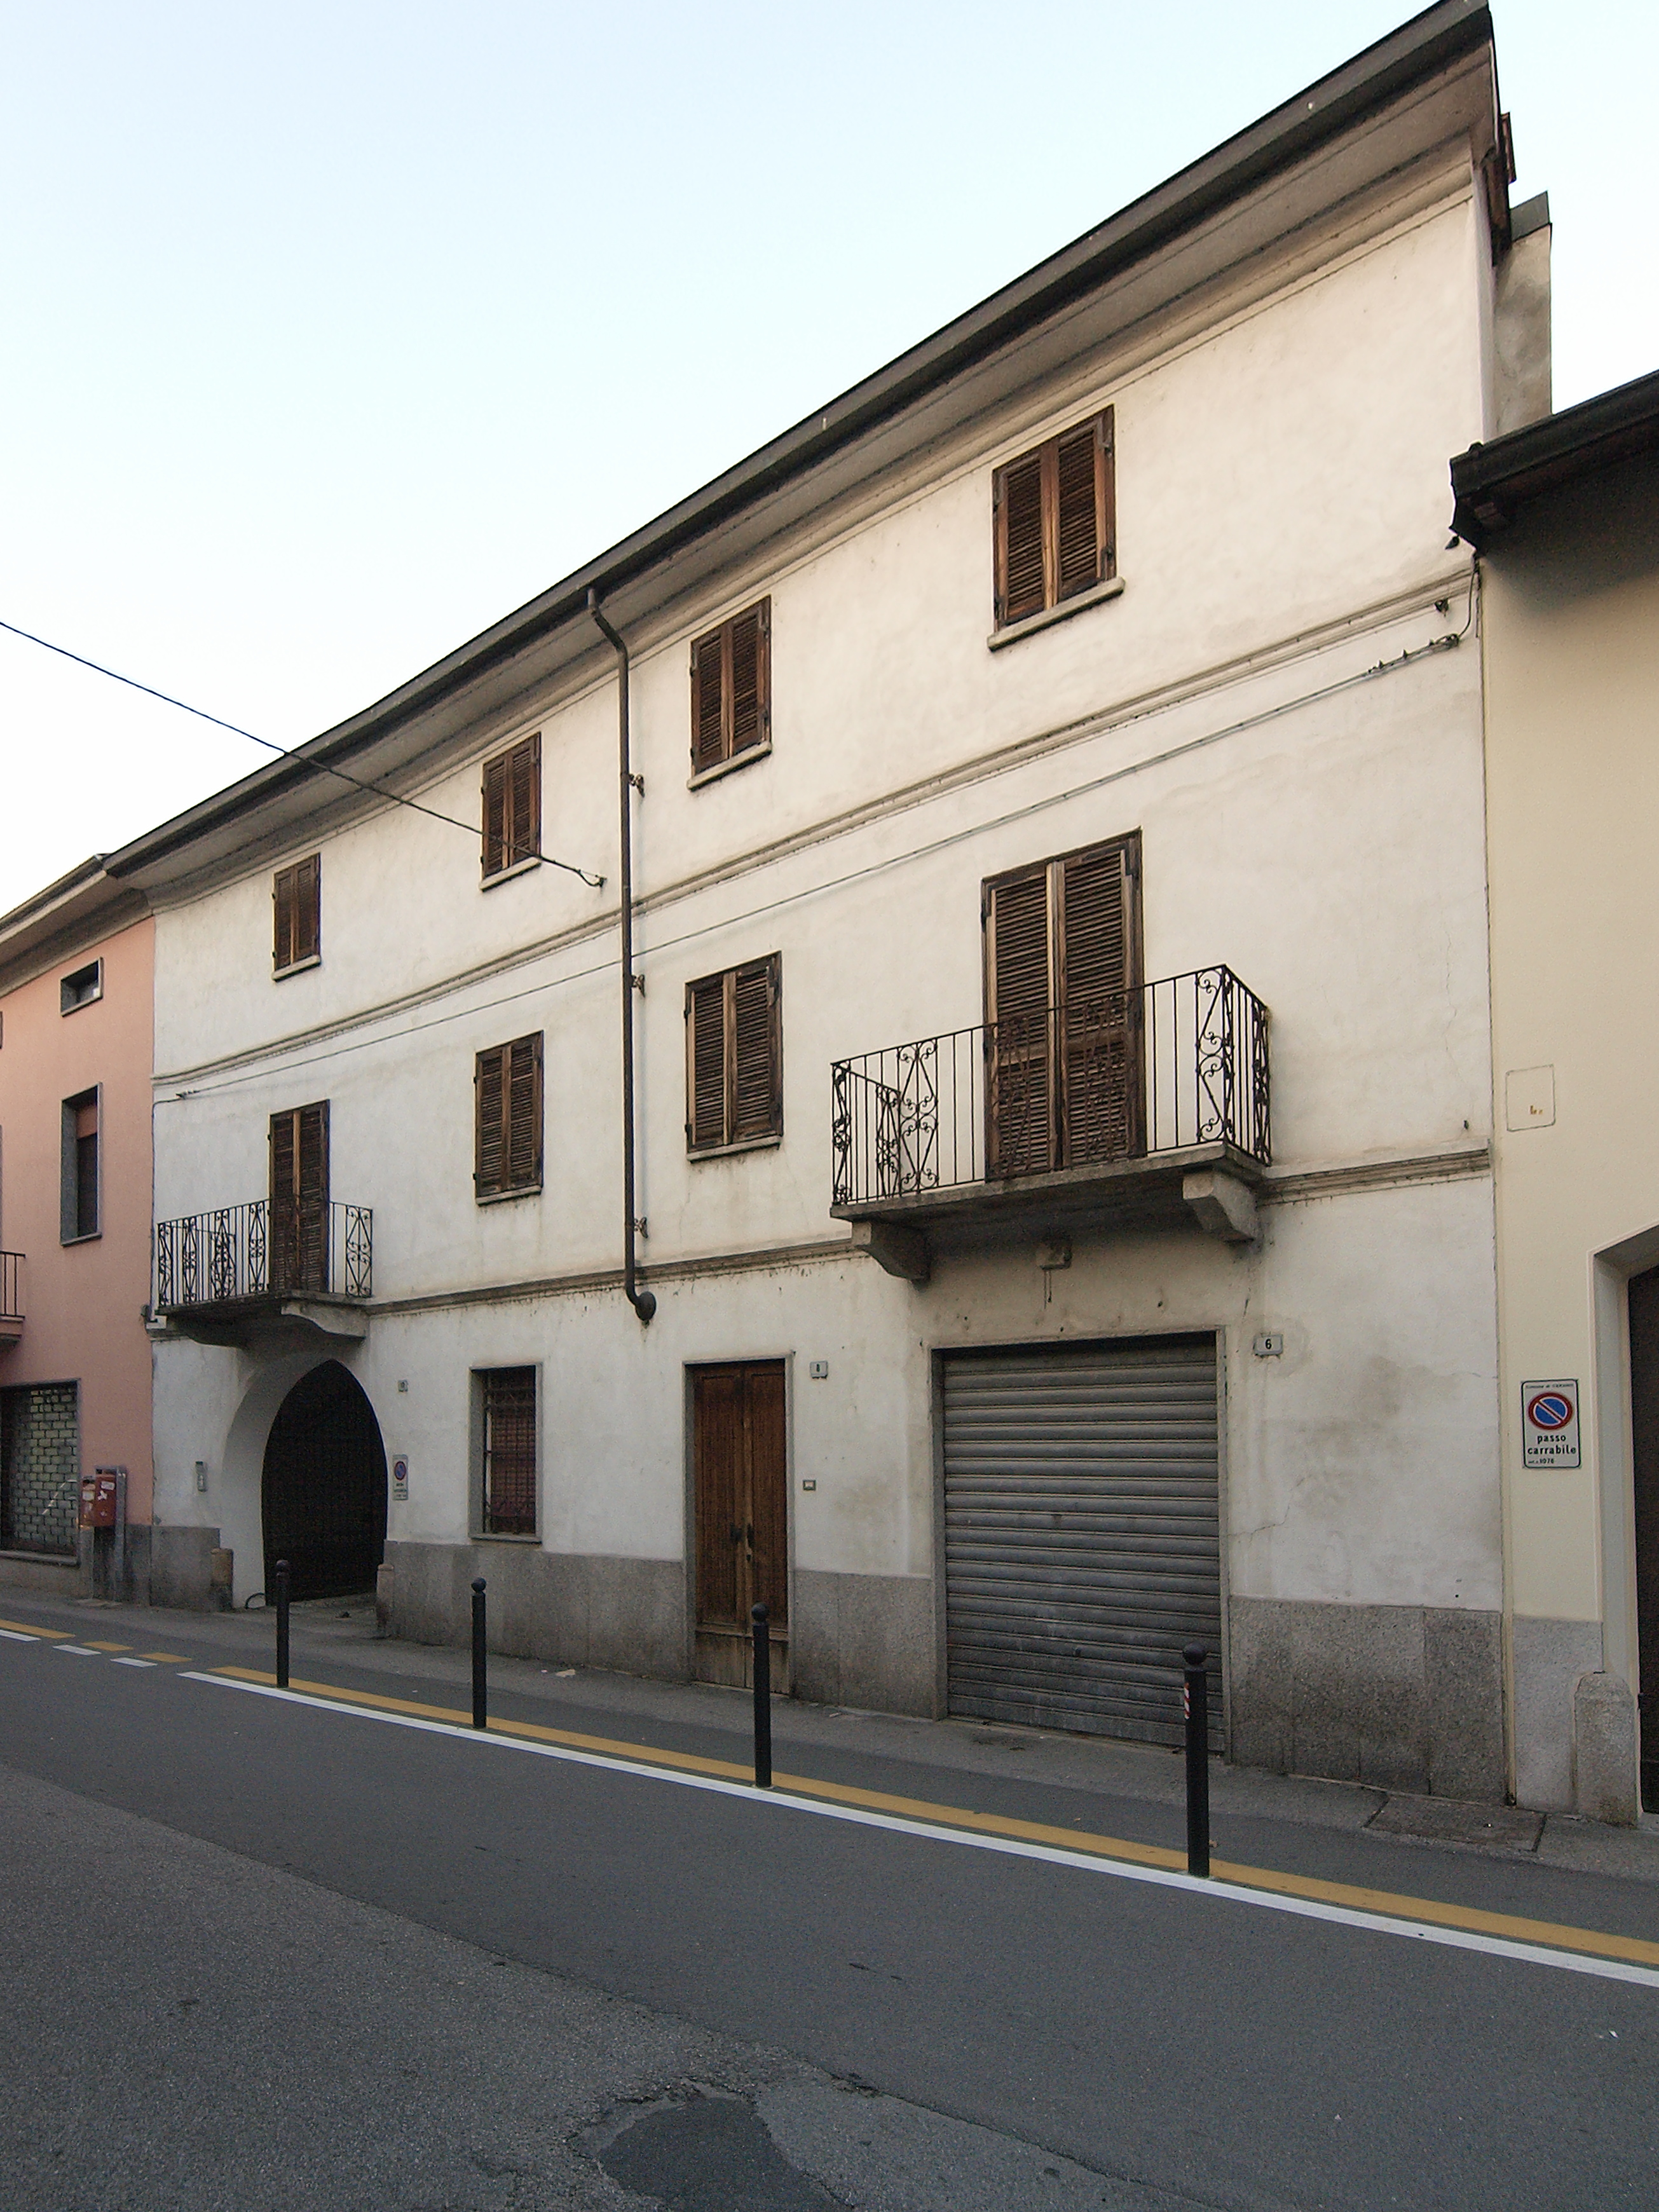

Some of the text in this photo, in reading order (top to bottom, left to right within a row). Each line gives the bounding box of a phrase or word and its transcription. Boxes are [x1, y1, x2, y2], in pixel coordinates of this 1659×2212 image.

[1266, 1338, 1272, 1349] 6
[1537, 1435, 1566, 1444] passo
[1527, 1445, 1576, 1454] carrabile
